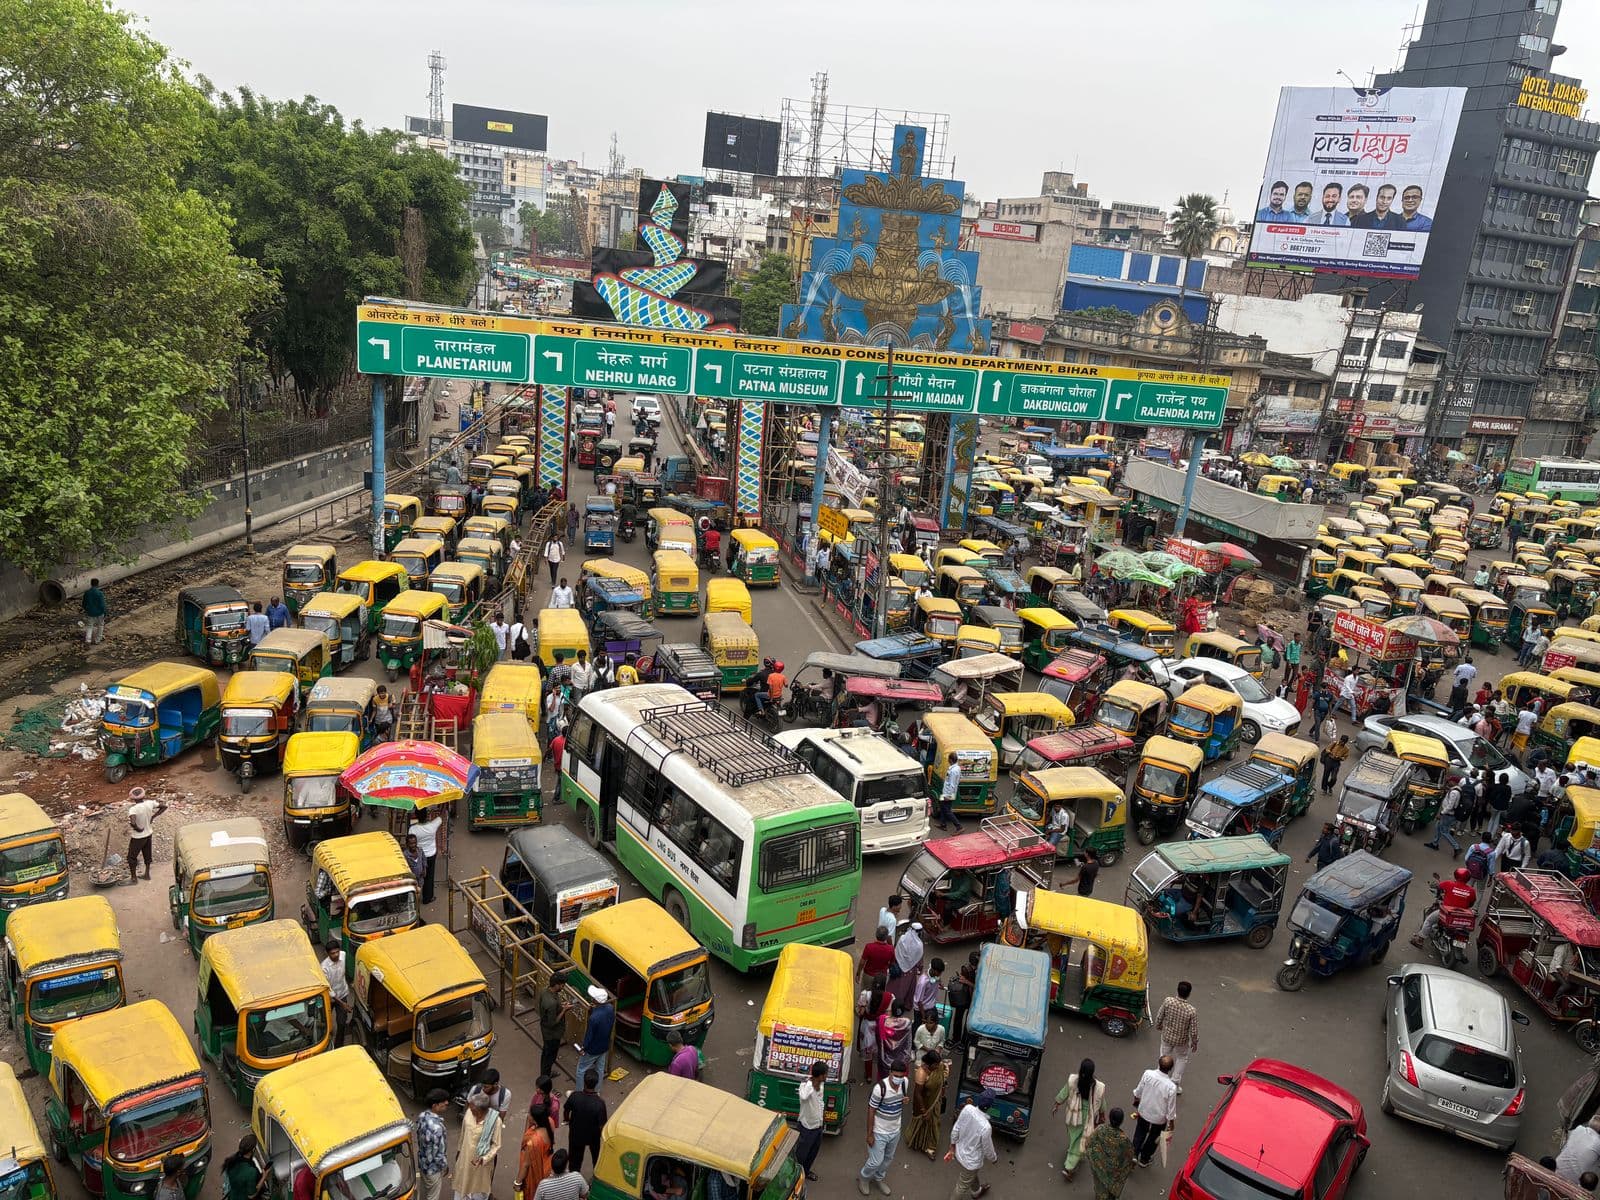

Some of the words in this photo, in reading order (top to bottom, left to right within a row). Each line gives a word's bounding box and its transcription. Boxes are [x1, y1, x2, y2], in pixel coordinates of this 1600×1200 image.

[1522, 75, 1550, 96] HOTEL
[1552, 82, 1588, 104] ADARSH
[1518, 92, 1582, 119] INTERNATIONAL
[1311, 125, 1411, 164] pratigya
[995, 223, 1020, 233] USHA
[366, 308, 409, 322] ओवरटेक
[413, 313, 421, 323] न
[434, 336, 496, 356] तारामंडल
[552, 325, 583, 337] पथ
[593, 326, 652, 343] निर्माण
[732, 336, 780, 352] बिहार
[417, 356, 512, 374] PLANETARIUM
[597, 346, 633, 366] नेहरू
[639, 350, 667, 370] मार्ग
[801, 345, 841, 357] ROAD
[961, 356, 1054, 373] DEPARTMENT,
[1059, 362, 1098, 376] BIHAR
[585, 369, 634, 386] NEHRU
[637, 373, 677, 388] MARG
[743, 364, 774, 378] पटना
[778, 366, 827, 383] संग्रहालय
[739, 379, 776, 393] PATNA
[779, 382, 828, 396] MUSEUM
[928, 375, 955, 391] मैदान
[1020, 382, 1062, 396] डाकबंगला
[1067, 383, 1096, 398] चौराहा
[926, 391, 964, 406] MAIDAN
[1023, 399, 1088, 414] DAKBUNGLOW
[1190, 395, 1209, 407] पथ
[1141, 407, 1189, 420] RAJENDRA
[1192, 410, 1216, 422] PATH
[1472, 421, 1489, 429] PATNA
[1337, 615, 1356, 632] पंजाबी
[1357, 623, 1371, 638] छोले
[656, 839, 666, 854] CNG
[667, 847, 676, 863] BUS
[760, 939, 779, 947] TATA
[778, 1045, 796, 1055] YOUTH
[796, 1048, 833, 1060] ADVERTISING
